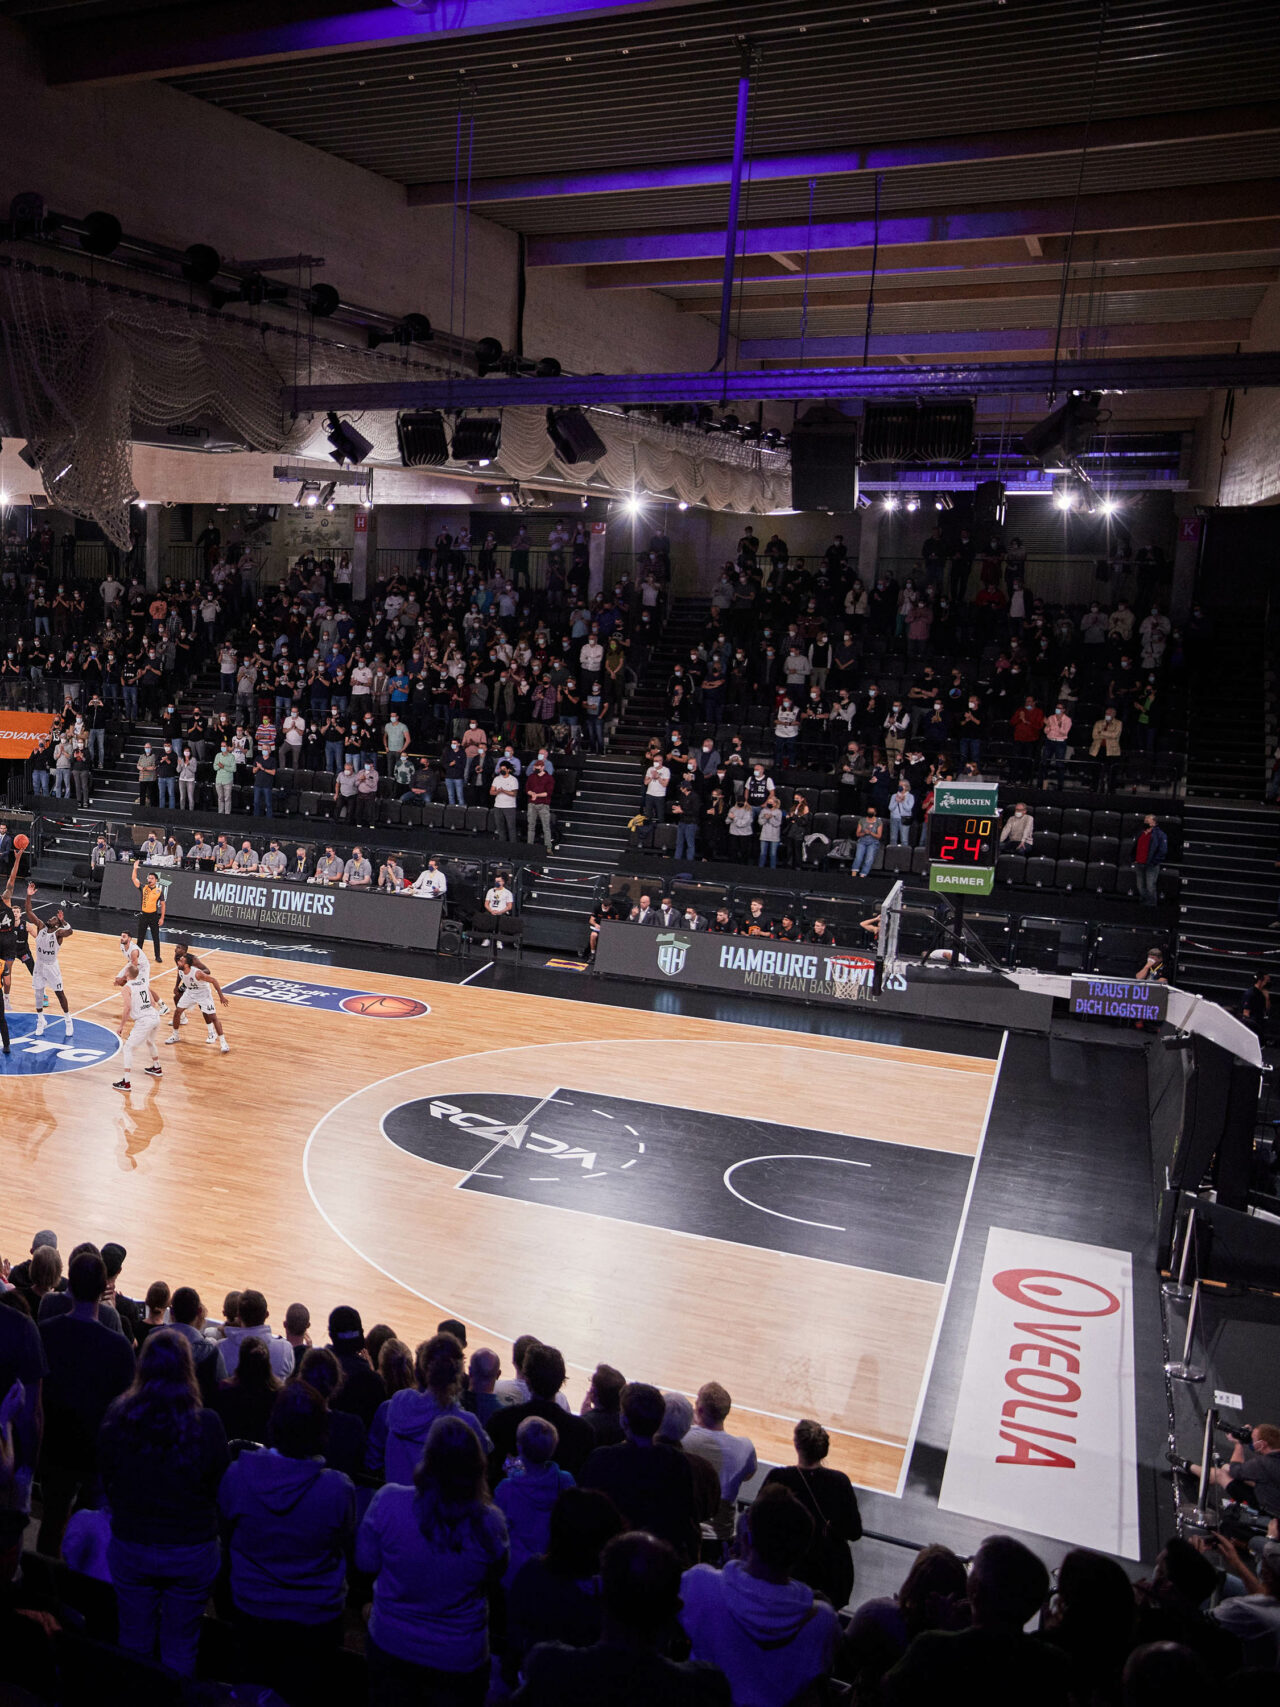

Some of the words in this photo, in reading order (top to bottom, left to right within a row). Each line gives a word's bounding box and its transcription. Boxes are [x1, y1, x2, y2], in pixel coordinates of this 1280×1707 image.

[357, 517, 365, 528] H
[1183, 523, 1194, 536] K
[956, 798, 991, 806] HOLSTEN
[940, 836, 981, 861] 24
[936, 875, 985, 886] BARMER
[193, 880, 267, 908] HAMBURG
[270, 888, 335, 916] TOWERS
[211, 903, 233, 918] MORE
[235, 906, 258, 921] THAN
[260, 909, 311, 928] BASKETBALL
[719, 945, 818, 979] HAMBURG
[824, 957, 908, 991] TOWS
[744, 971, 773, 988] MORE
[777, 974, 806, 993] THAN
[1088, 981, 1130, 999] TRAUST
[1132, 985, 1150, 1001] DU
[139, 990, 150, 1004] 12
[232, 986, 313, 1005] BBL
[1075, 998, 1103, 1014] DICH
[1105, 1001, 1160, 1021] LOGISTIK?
[995, 1322, 1082, 1469] VEOLIA
